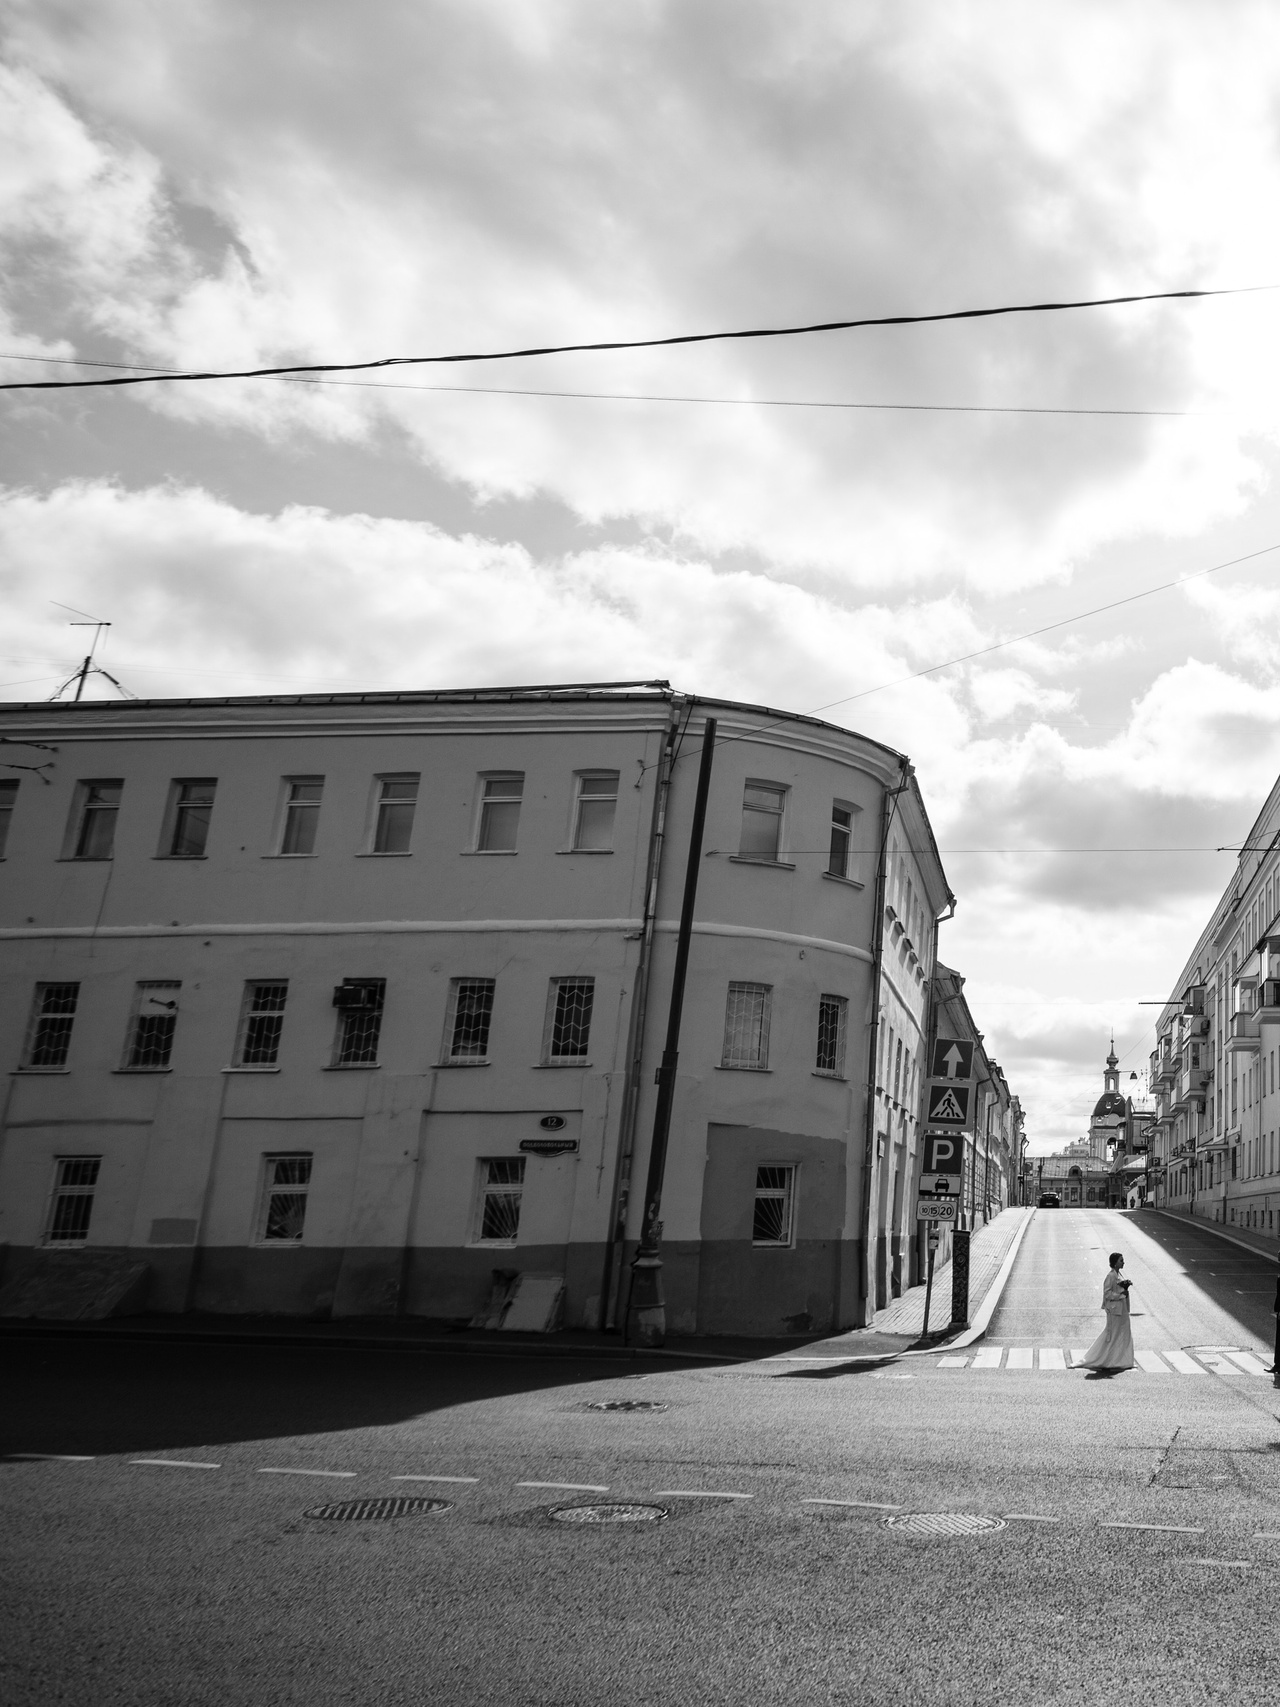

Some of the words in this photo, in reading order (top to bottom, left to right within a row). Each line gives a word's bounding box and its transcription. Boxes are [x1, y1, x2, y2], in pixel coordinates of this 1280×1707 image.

[547, 1117, 557, 1126] 12
[931, 1139, 954, 1170] P
[940, 1206, 952, 1216] 20
